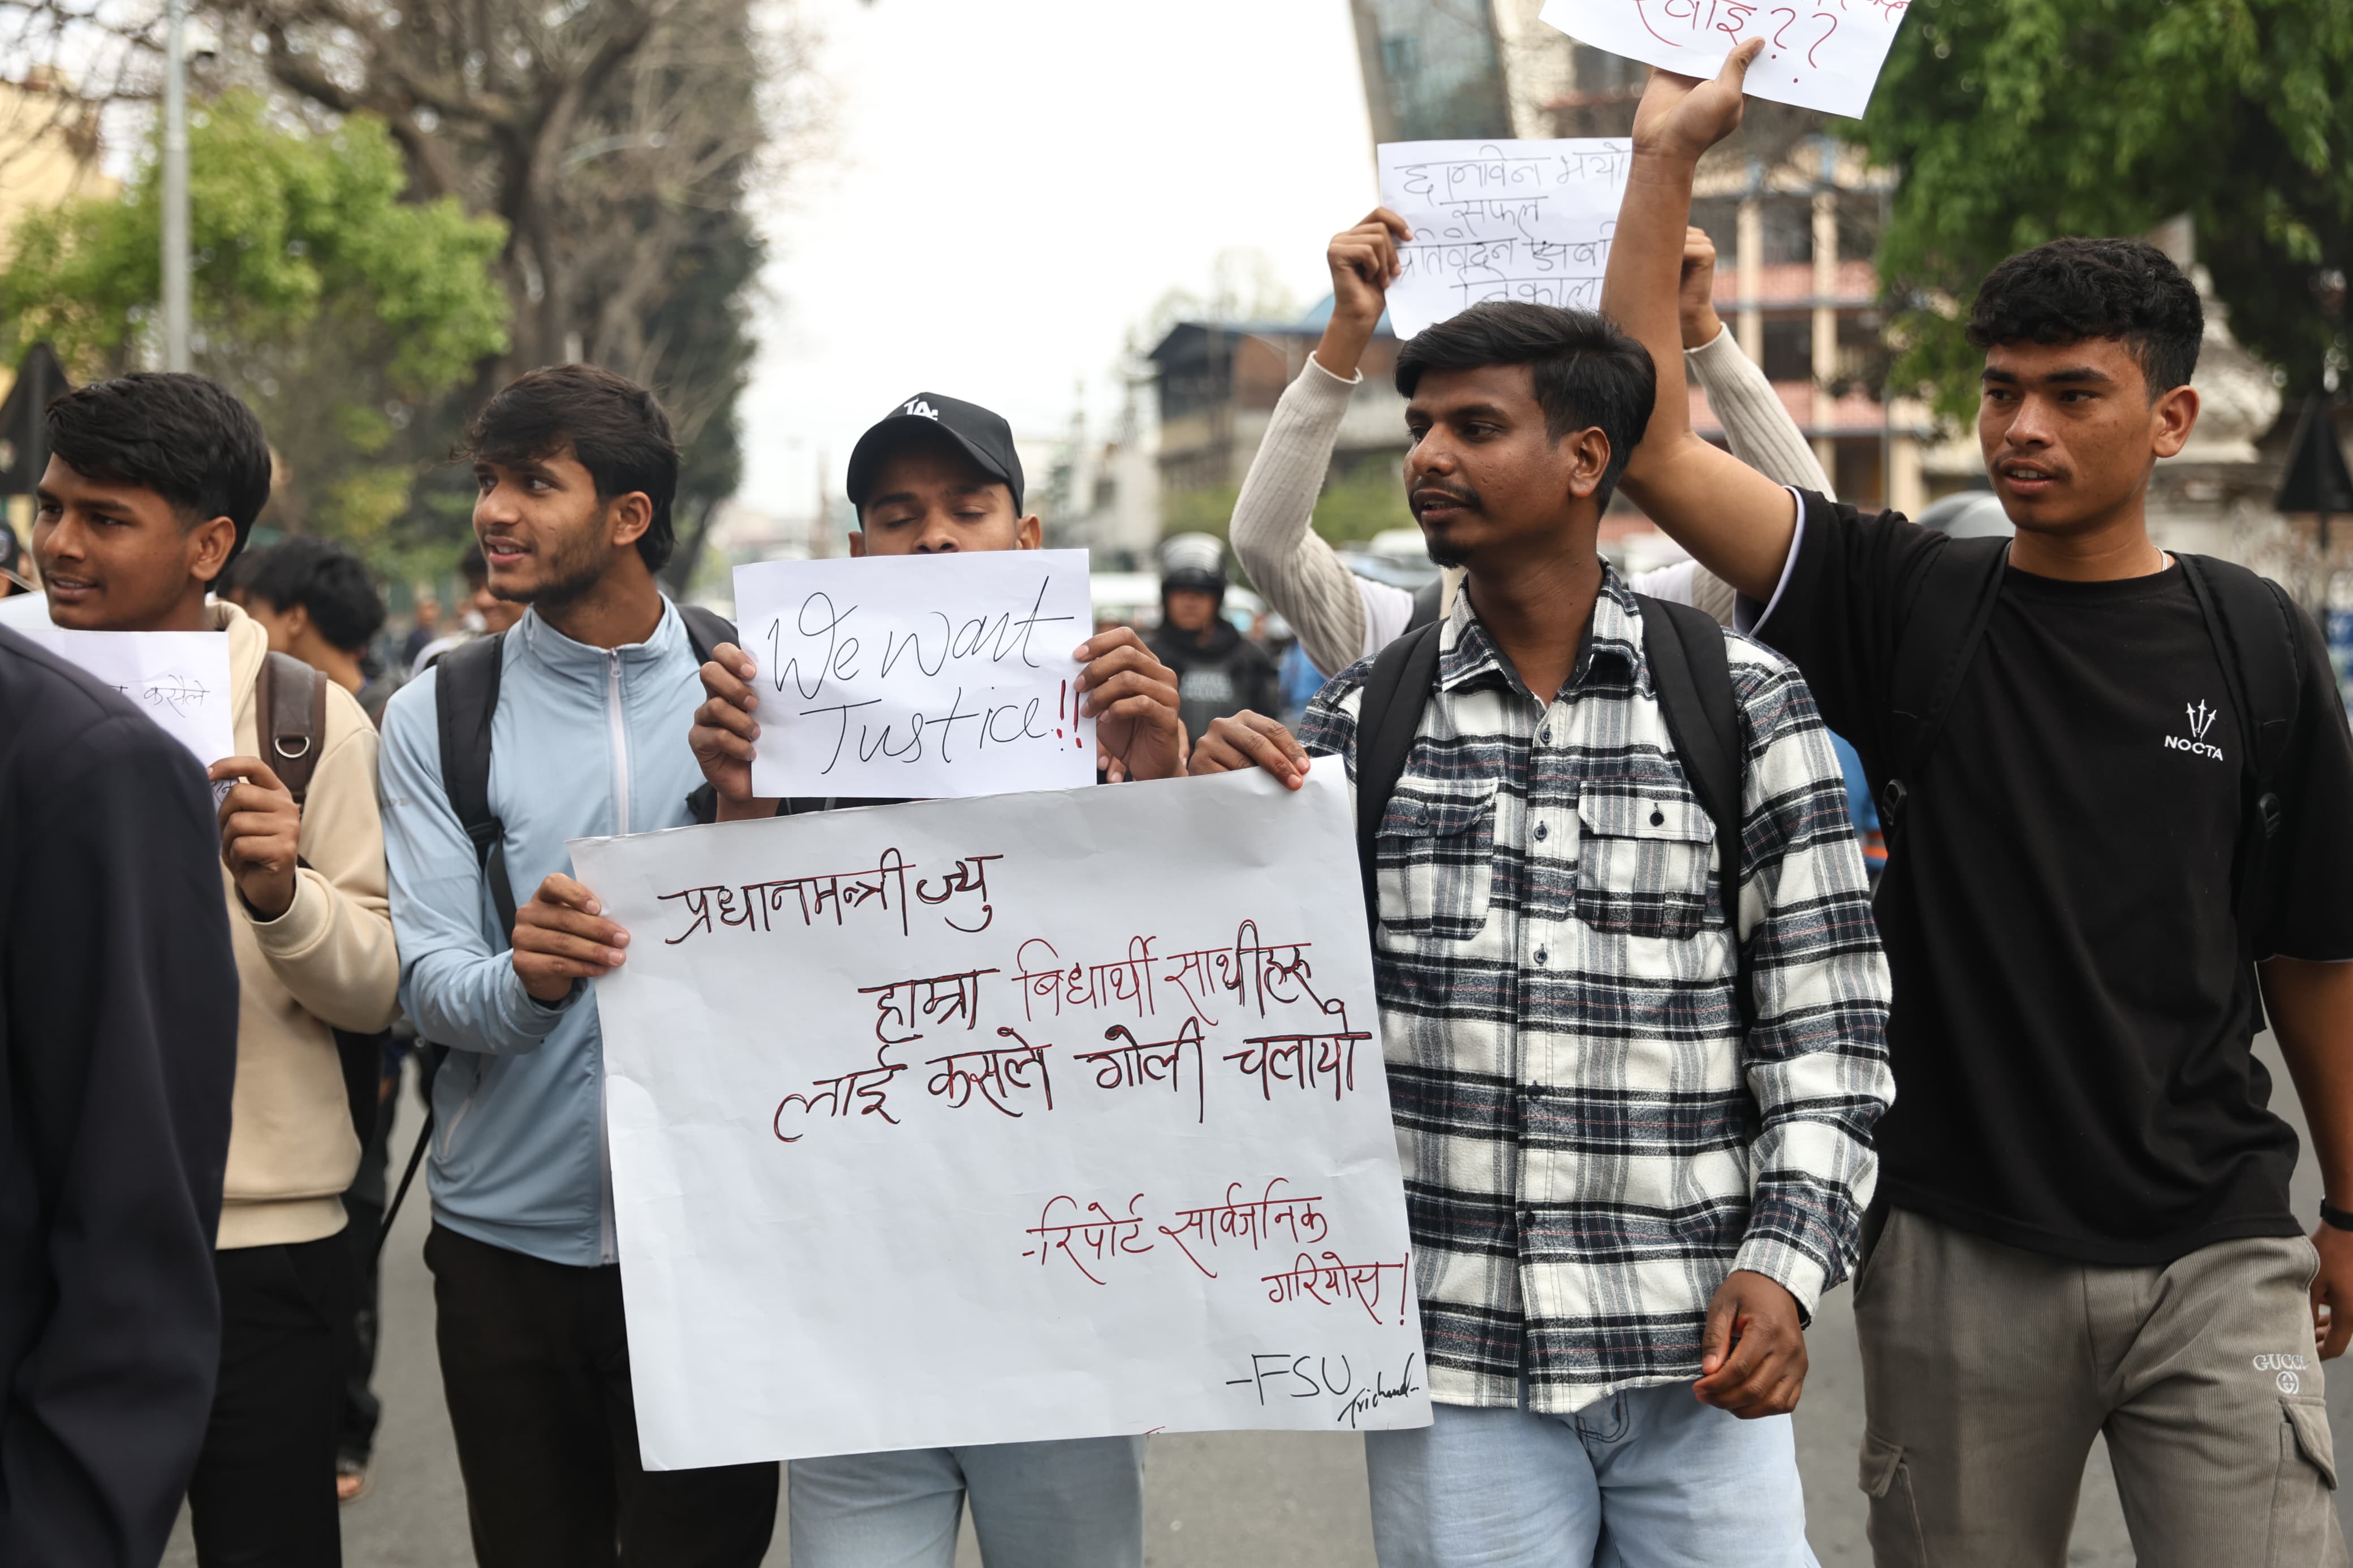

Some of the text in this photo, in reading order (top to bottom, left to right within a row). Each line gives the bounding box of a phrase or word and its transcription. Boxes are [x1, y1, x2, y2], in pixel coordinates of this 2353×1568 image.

[768, 592, 860, 699] We
[2164, 735, 2223, 761] NOCTA
[774, 1044, 908, 1142] लाई
[2253, 1354, 2309, 1371] GUCCI
